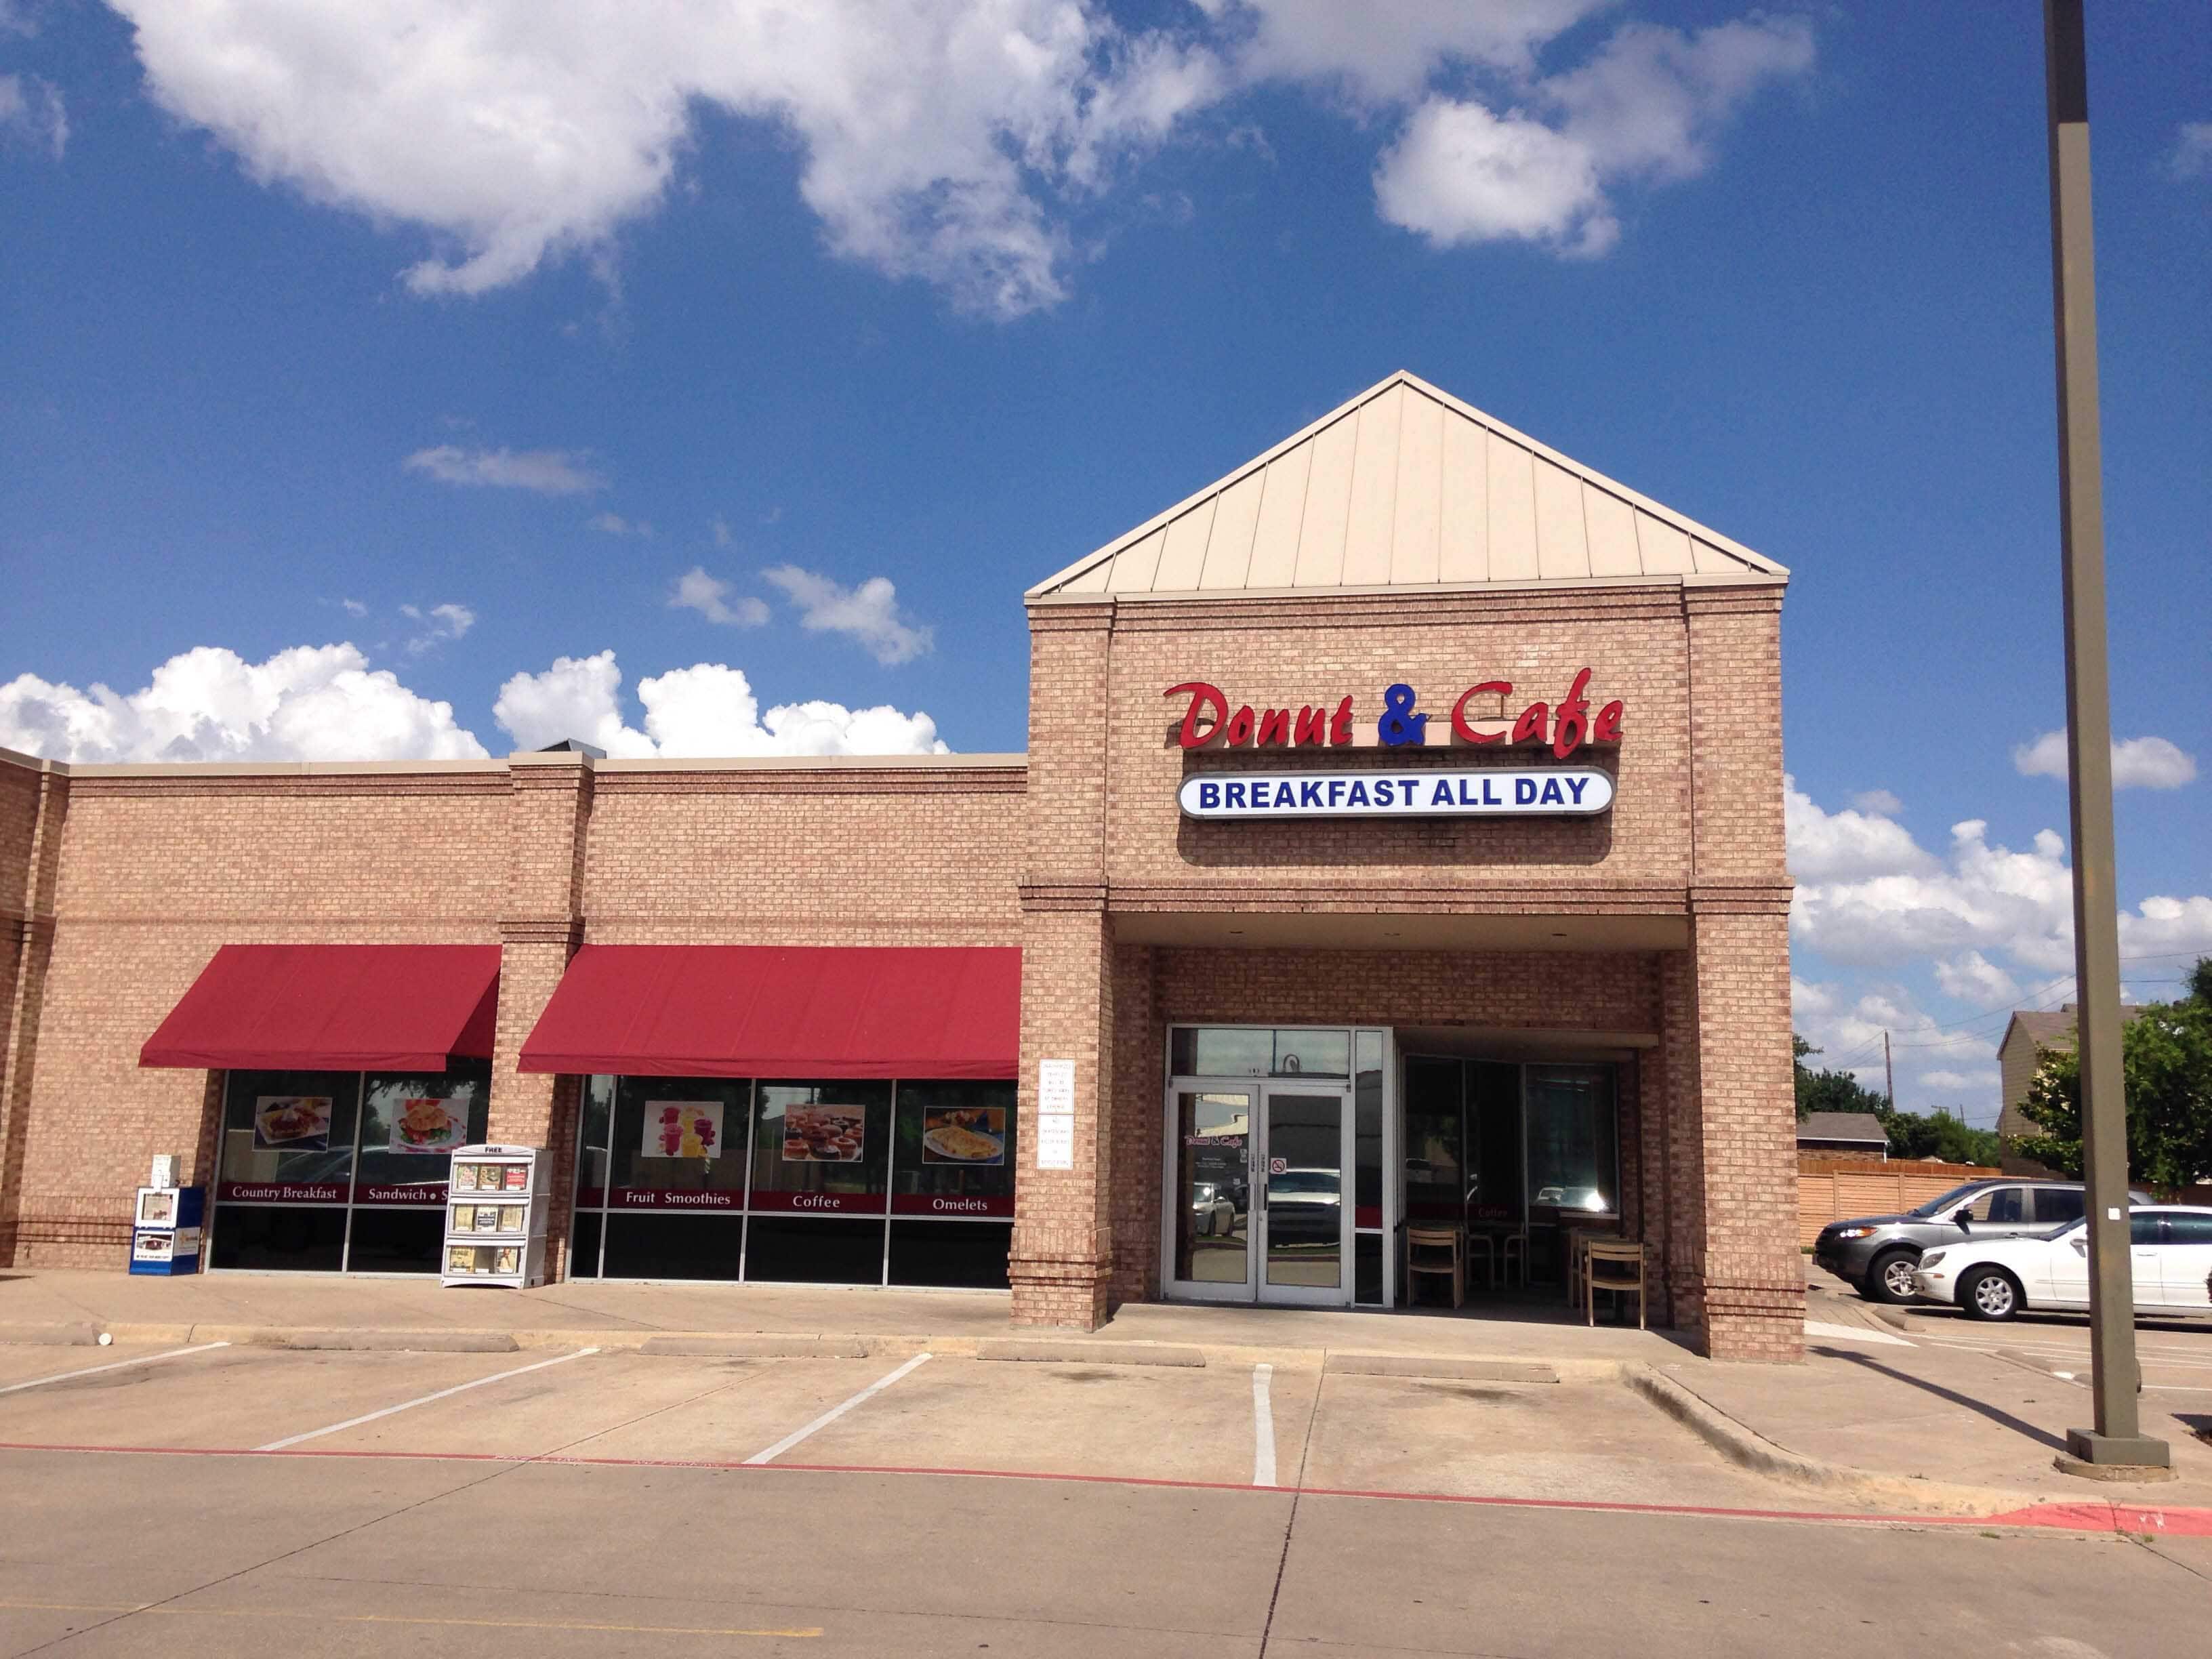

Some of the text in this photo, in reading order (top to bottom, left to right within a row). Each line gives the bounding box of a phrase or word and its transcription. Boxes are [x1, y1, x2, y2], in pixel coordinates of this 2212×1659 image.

[1164, 667, 1624, 760] Donut & Cafe
[1199, 777, 1590, 809] BREAKFAST ALL DAY
[232, 1186, 337, 1201] Country Breakfast
[368, 1188, 426, 1200] Sandwich
[626, 1191, 731, 1204] Fruit Smoothies
[792, 1195, 840, 1208] Coffee
[933, 1198, 988, 1211] Omelets
